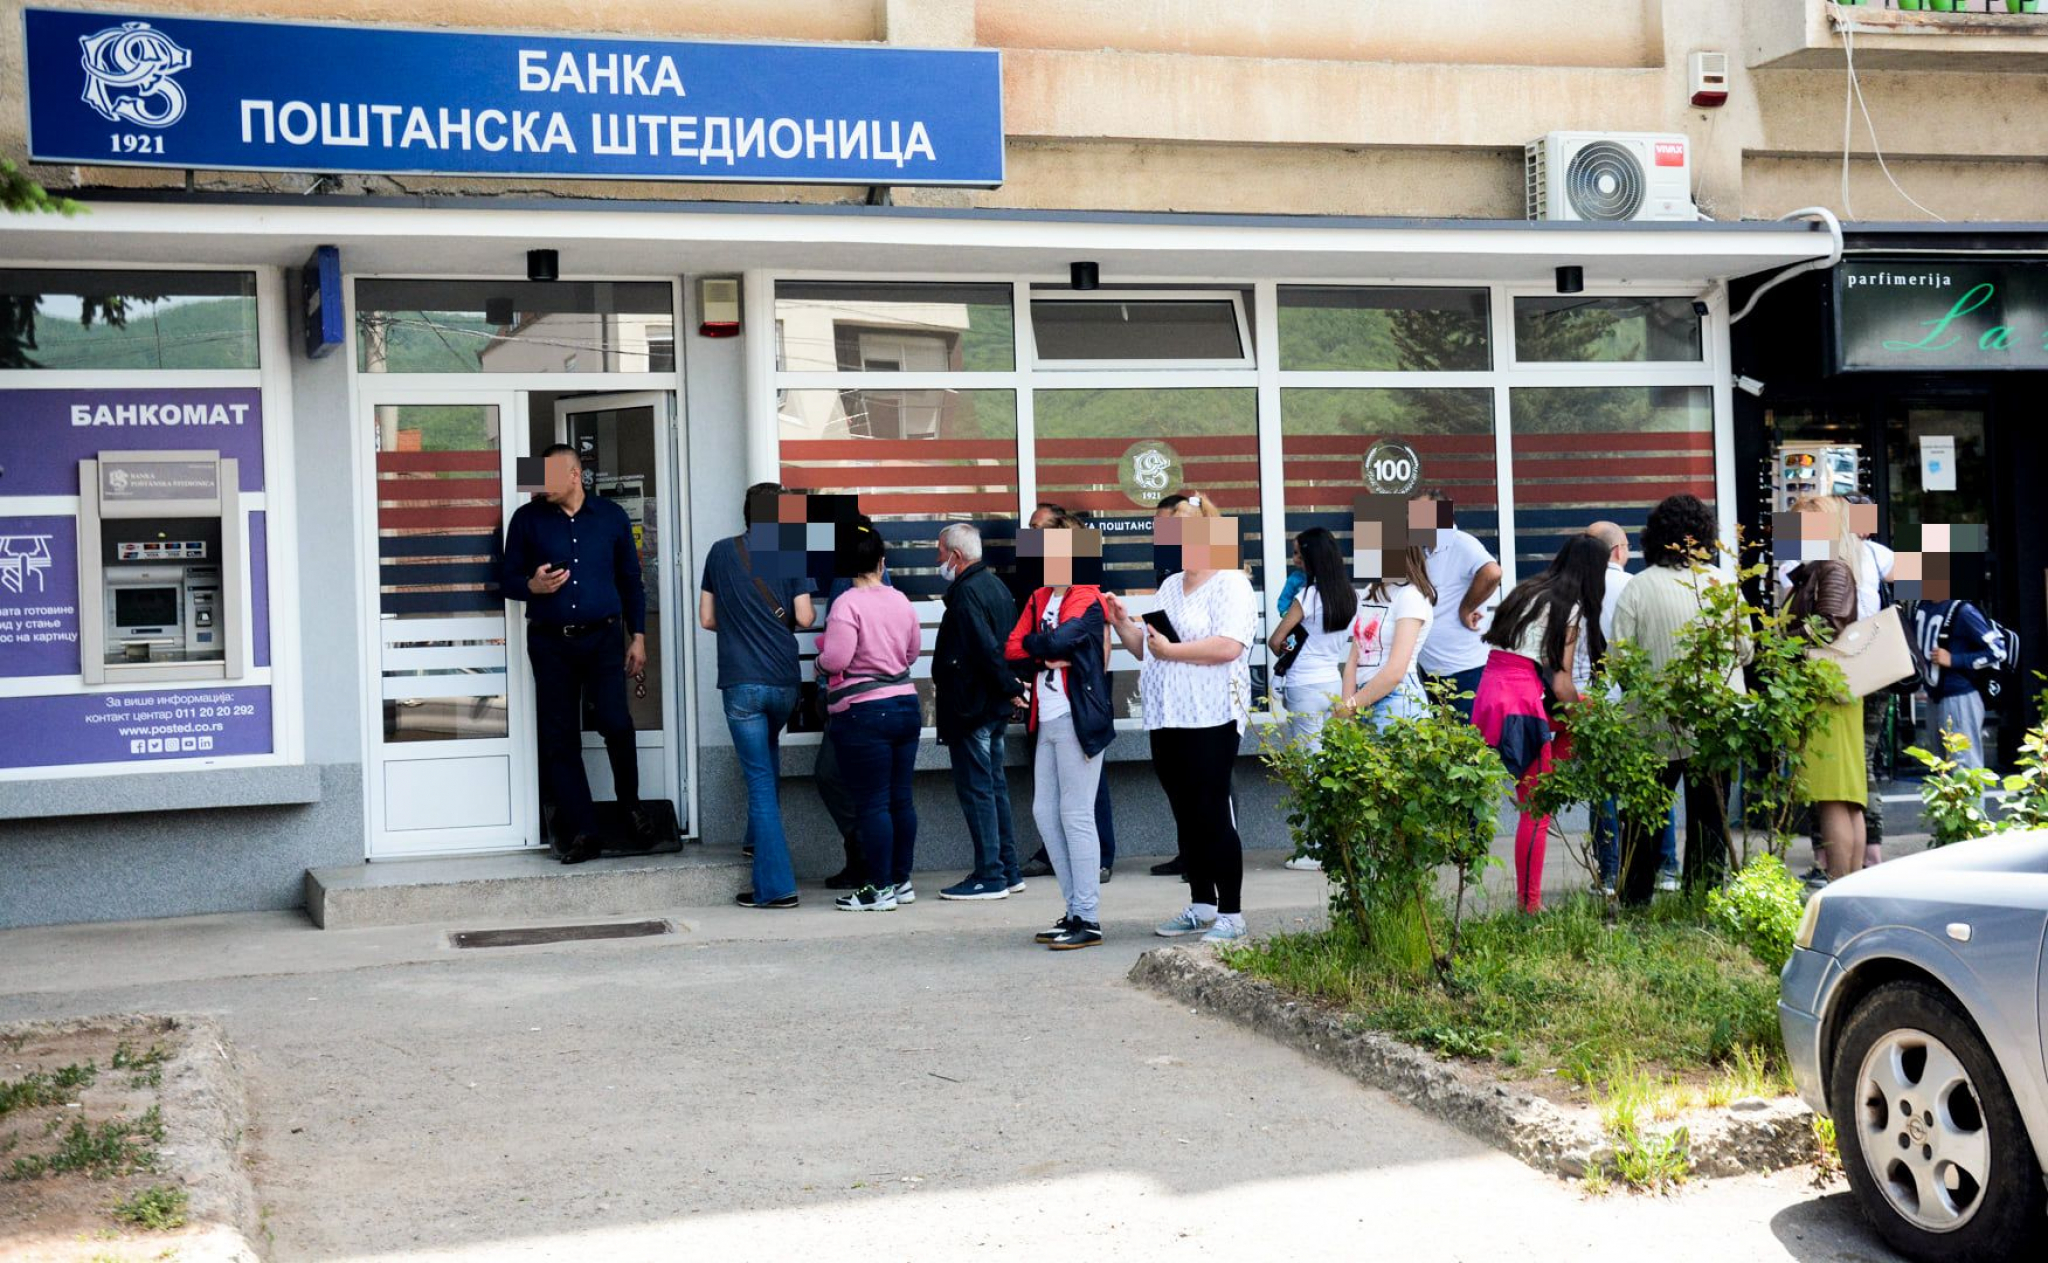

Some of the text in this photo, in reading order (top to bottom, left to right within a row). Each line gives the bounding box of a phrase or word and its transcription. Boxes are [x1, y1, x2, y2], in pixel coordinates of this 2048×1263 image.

[518, 50, 686, 97] БАНКА
[241, 99, 936, 168] ПОШТАНСКА ШТЕДИОНИЦА
[110, 133, 165, 154] 1921
[1847, 272, 1951, 289] parfimerija
[70, 404, 249, 426] БАНКОМАТ
[1373, 459, 1411, 482] 100
[1142, 492, 1161, 500] 1921
[1099, 521, 1154, 531] ПОШТАНС
[24, 606, 74, 615] готовине
[16, 634, 30, 642] на
[33, 632, 78, 643] картицу
[105, 696, 121, 707] За
[124, 697, 154, 706] више
[85, 704, 255, 723] контакт центар 011 20 20 292
[118, 722, 224, 737] www.posted.co.rs
